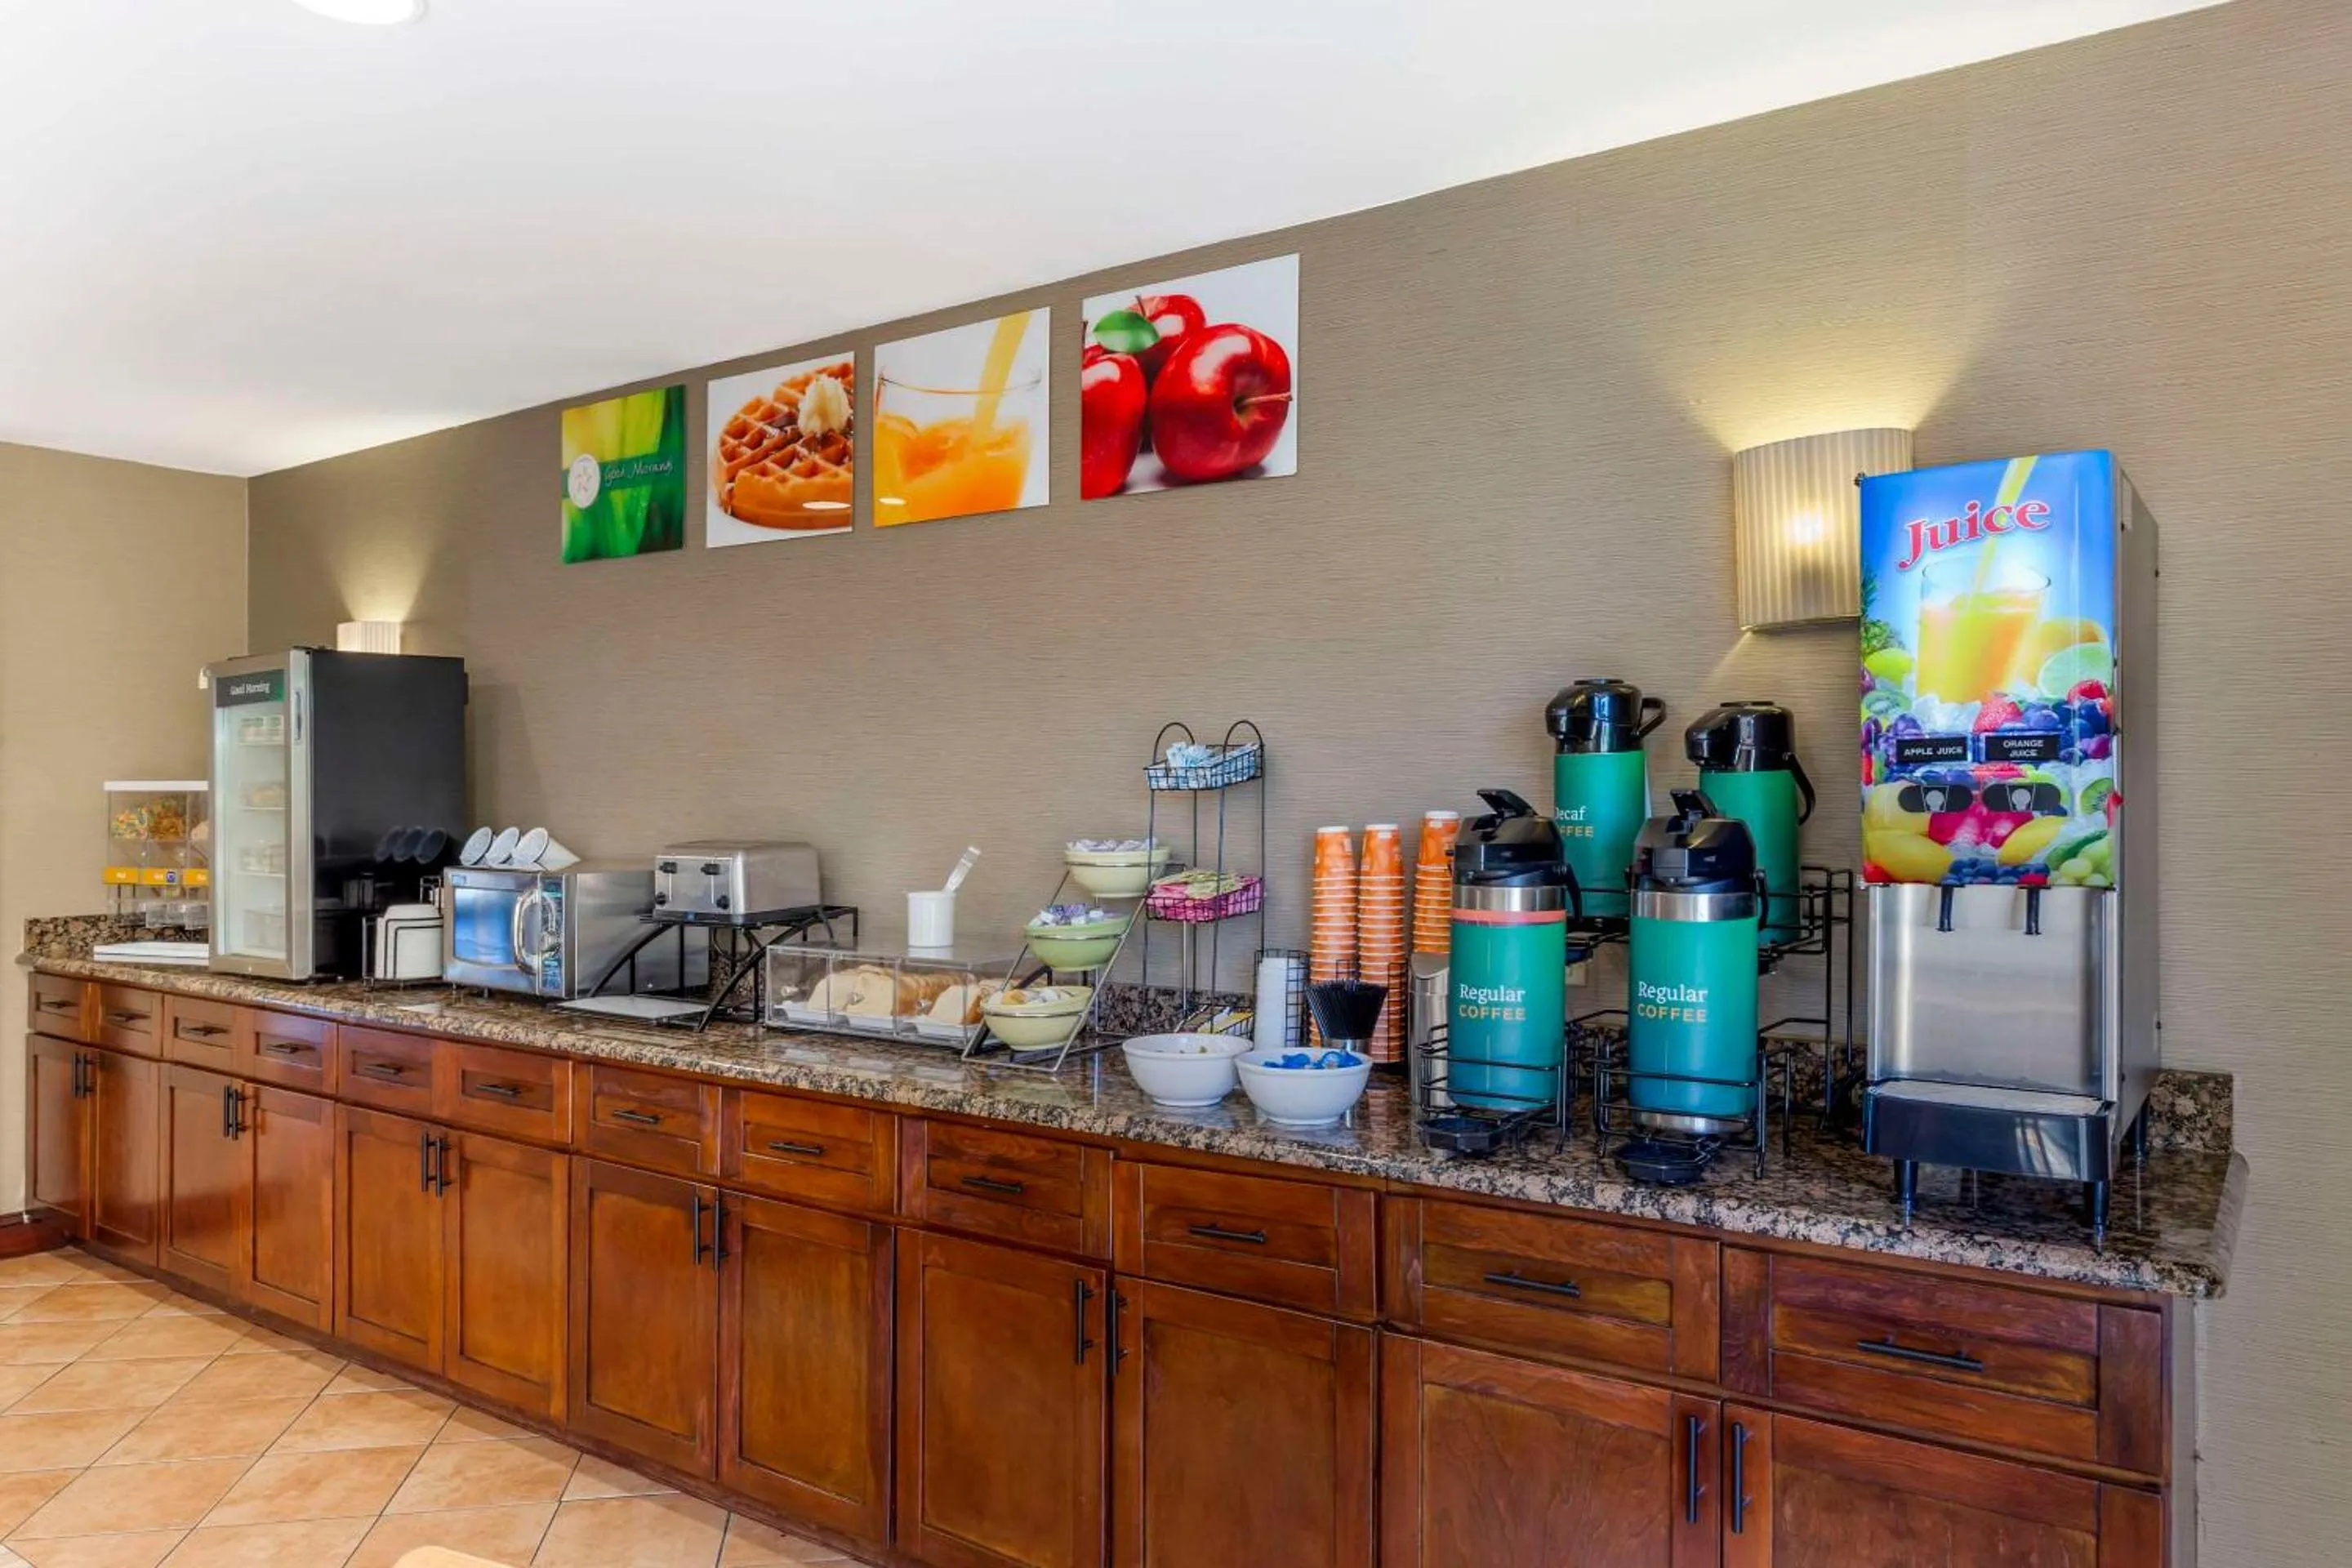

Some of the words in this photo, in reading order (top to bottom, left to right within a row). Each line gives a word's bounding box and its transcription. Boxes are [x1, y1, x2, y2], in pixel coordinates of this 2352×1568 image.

[1897, 501, 2051, 570] Juice
[1904, 747, 1933, 756] APPLE
[1936, 746, 1963, 755] JUICE
[2002, 739, 2044, 748] ORANGE
[2009, 750, 2038, 758] JUICE
[1556, 825, 1594, 838] FFEE
[1459, 983, 1526, 1004] Regular
[1637, 981, 1708, 1004] Regular
[1459, 1004, 1526, 1021] COFFEE
[1637, 1003, 1707, 1023] COFFEE
